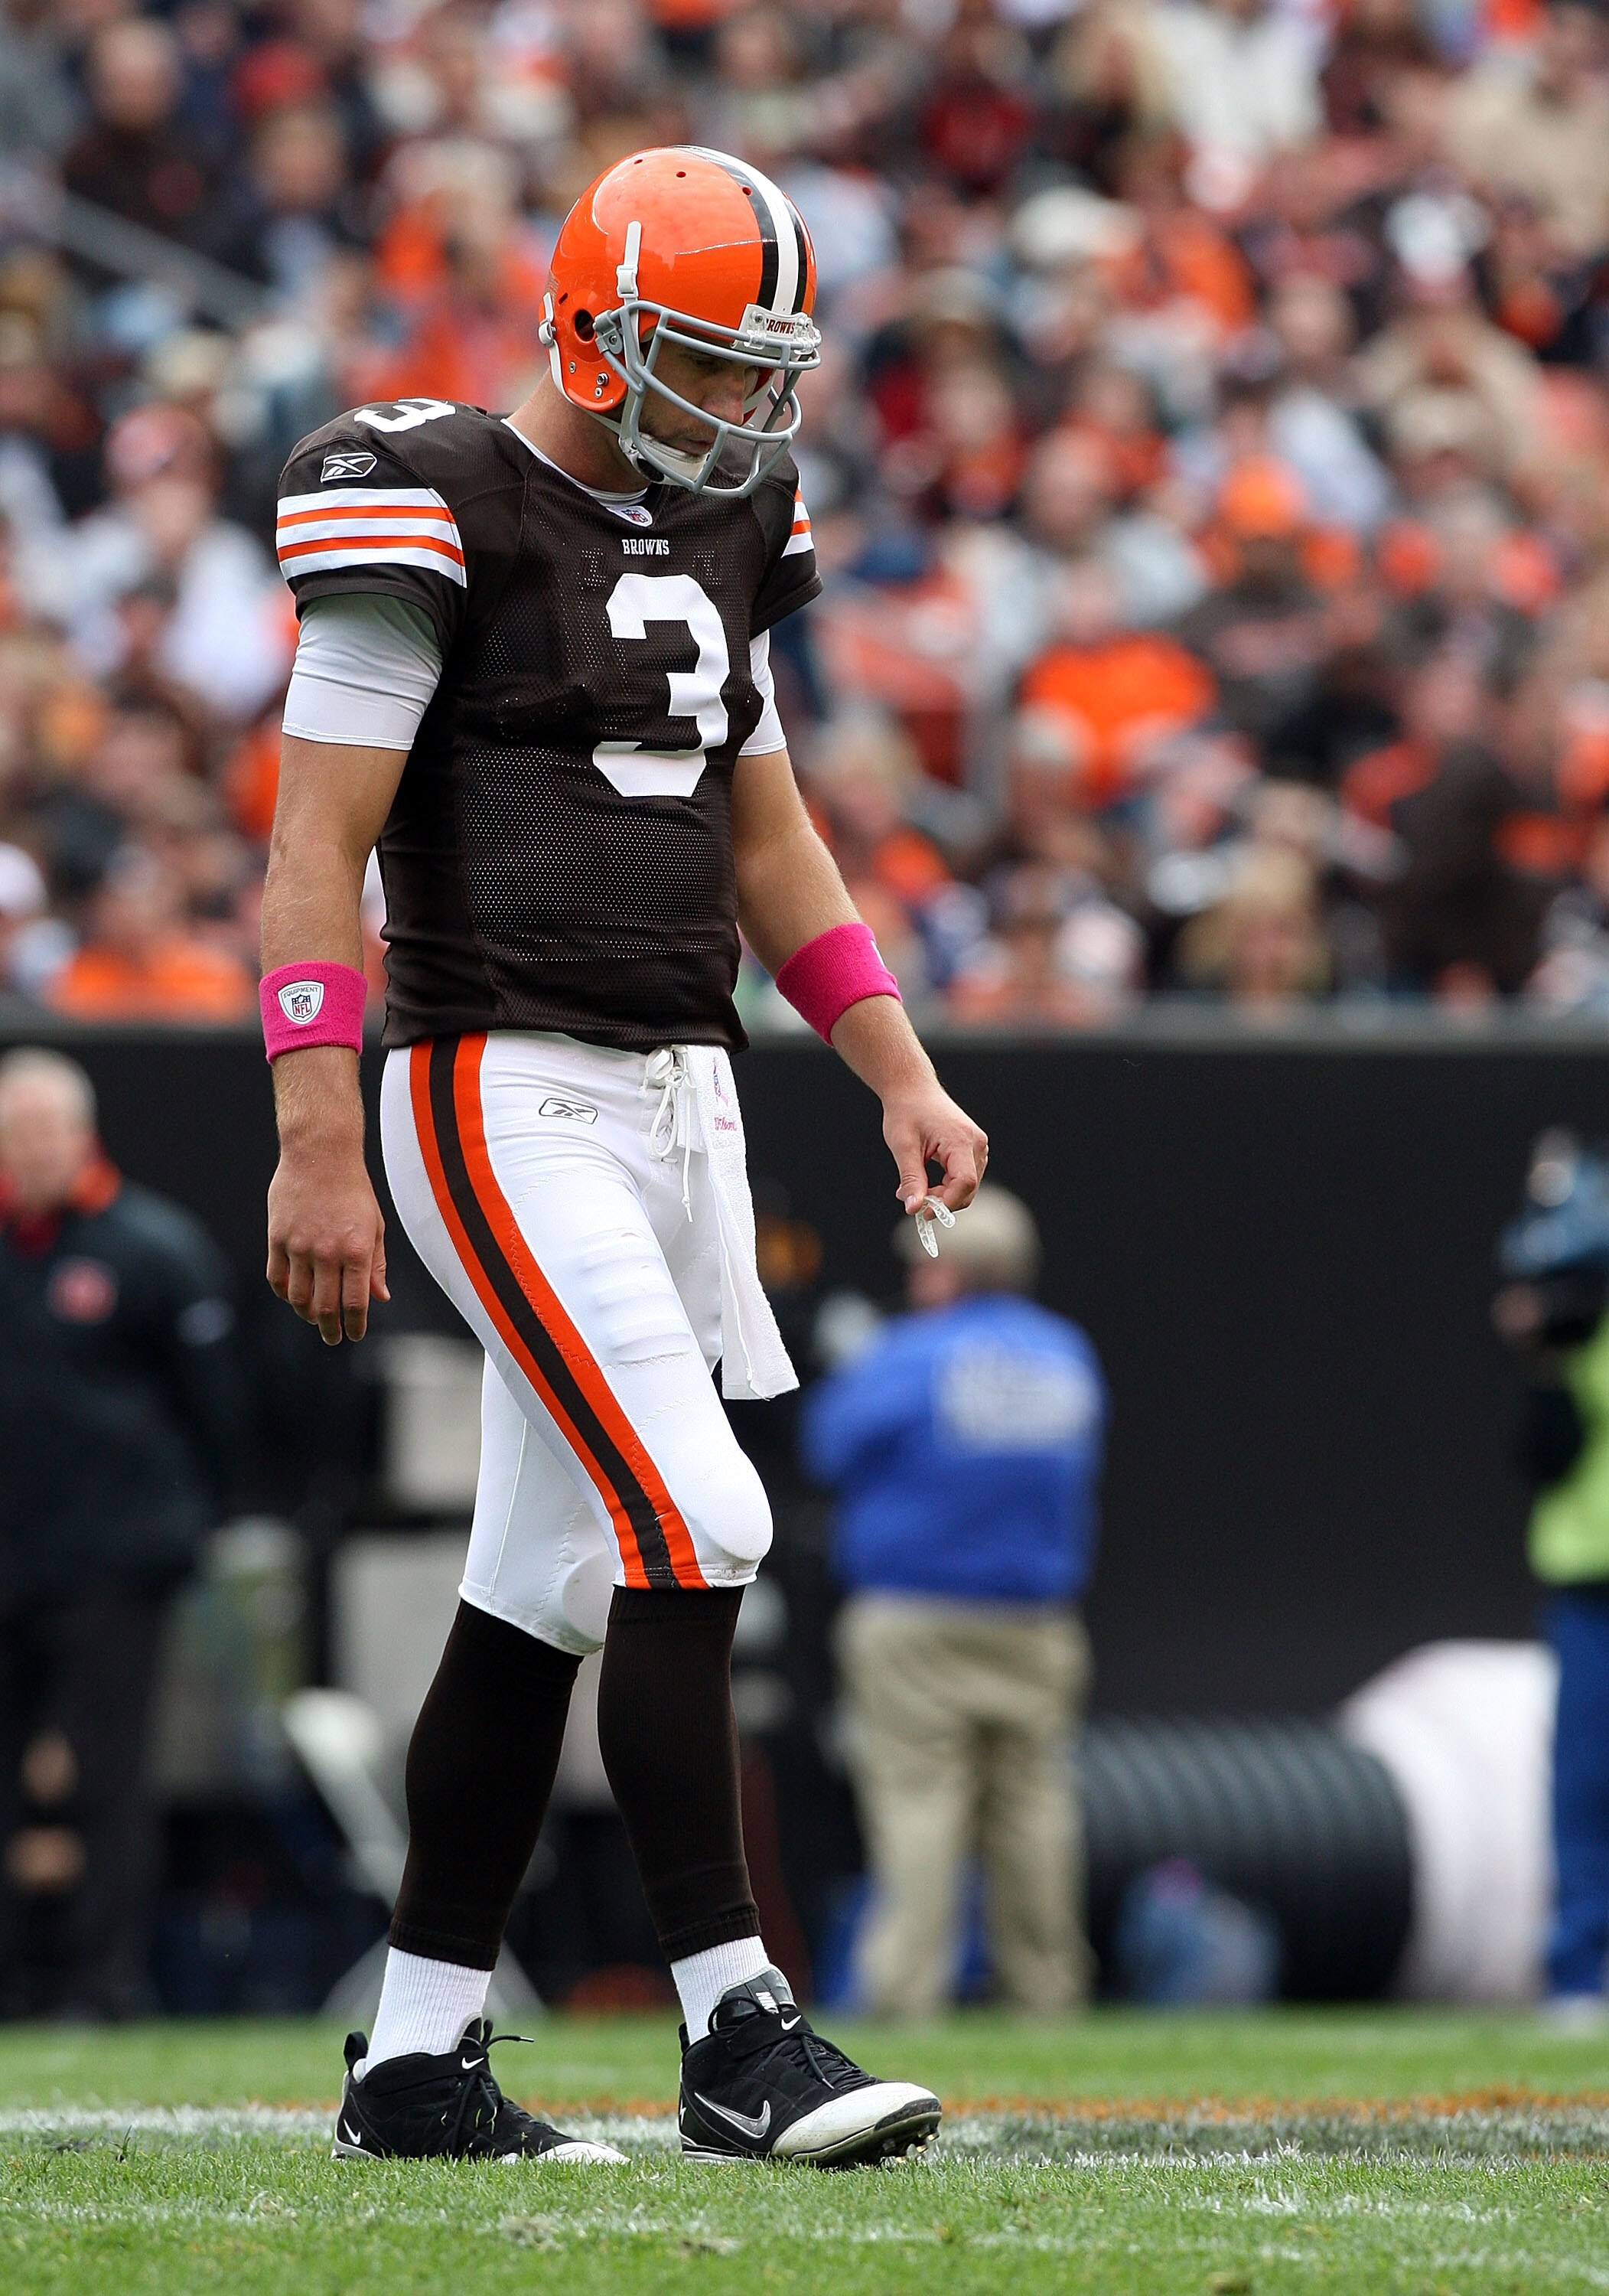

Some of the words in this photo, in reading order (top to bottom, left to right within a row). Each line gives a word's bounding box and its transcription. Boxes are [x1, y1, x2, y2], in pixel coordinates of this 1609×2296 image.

[767, 318, 795, 334] ROWNS
[353, 397, 457, 433] 3
[621, 539, 670, 556] BROWNS
[592, 572, 730, 797] 3
[283, 987, 318, 998] EQUIPMENT
[294, 1003, 311, 1016] NFL
